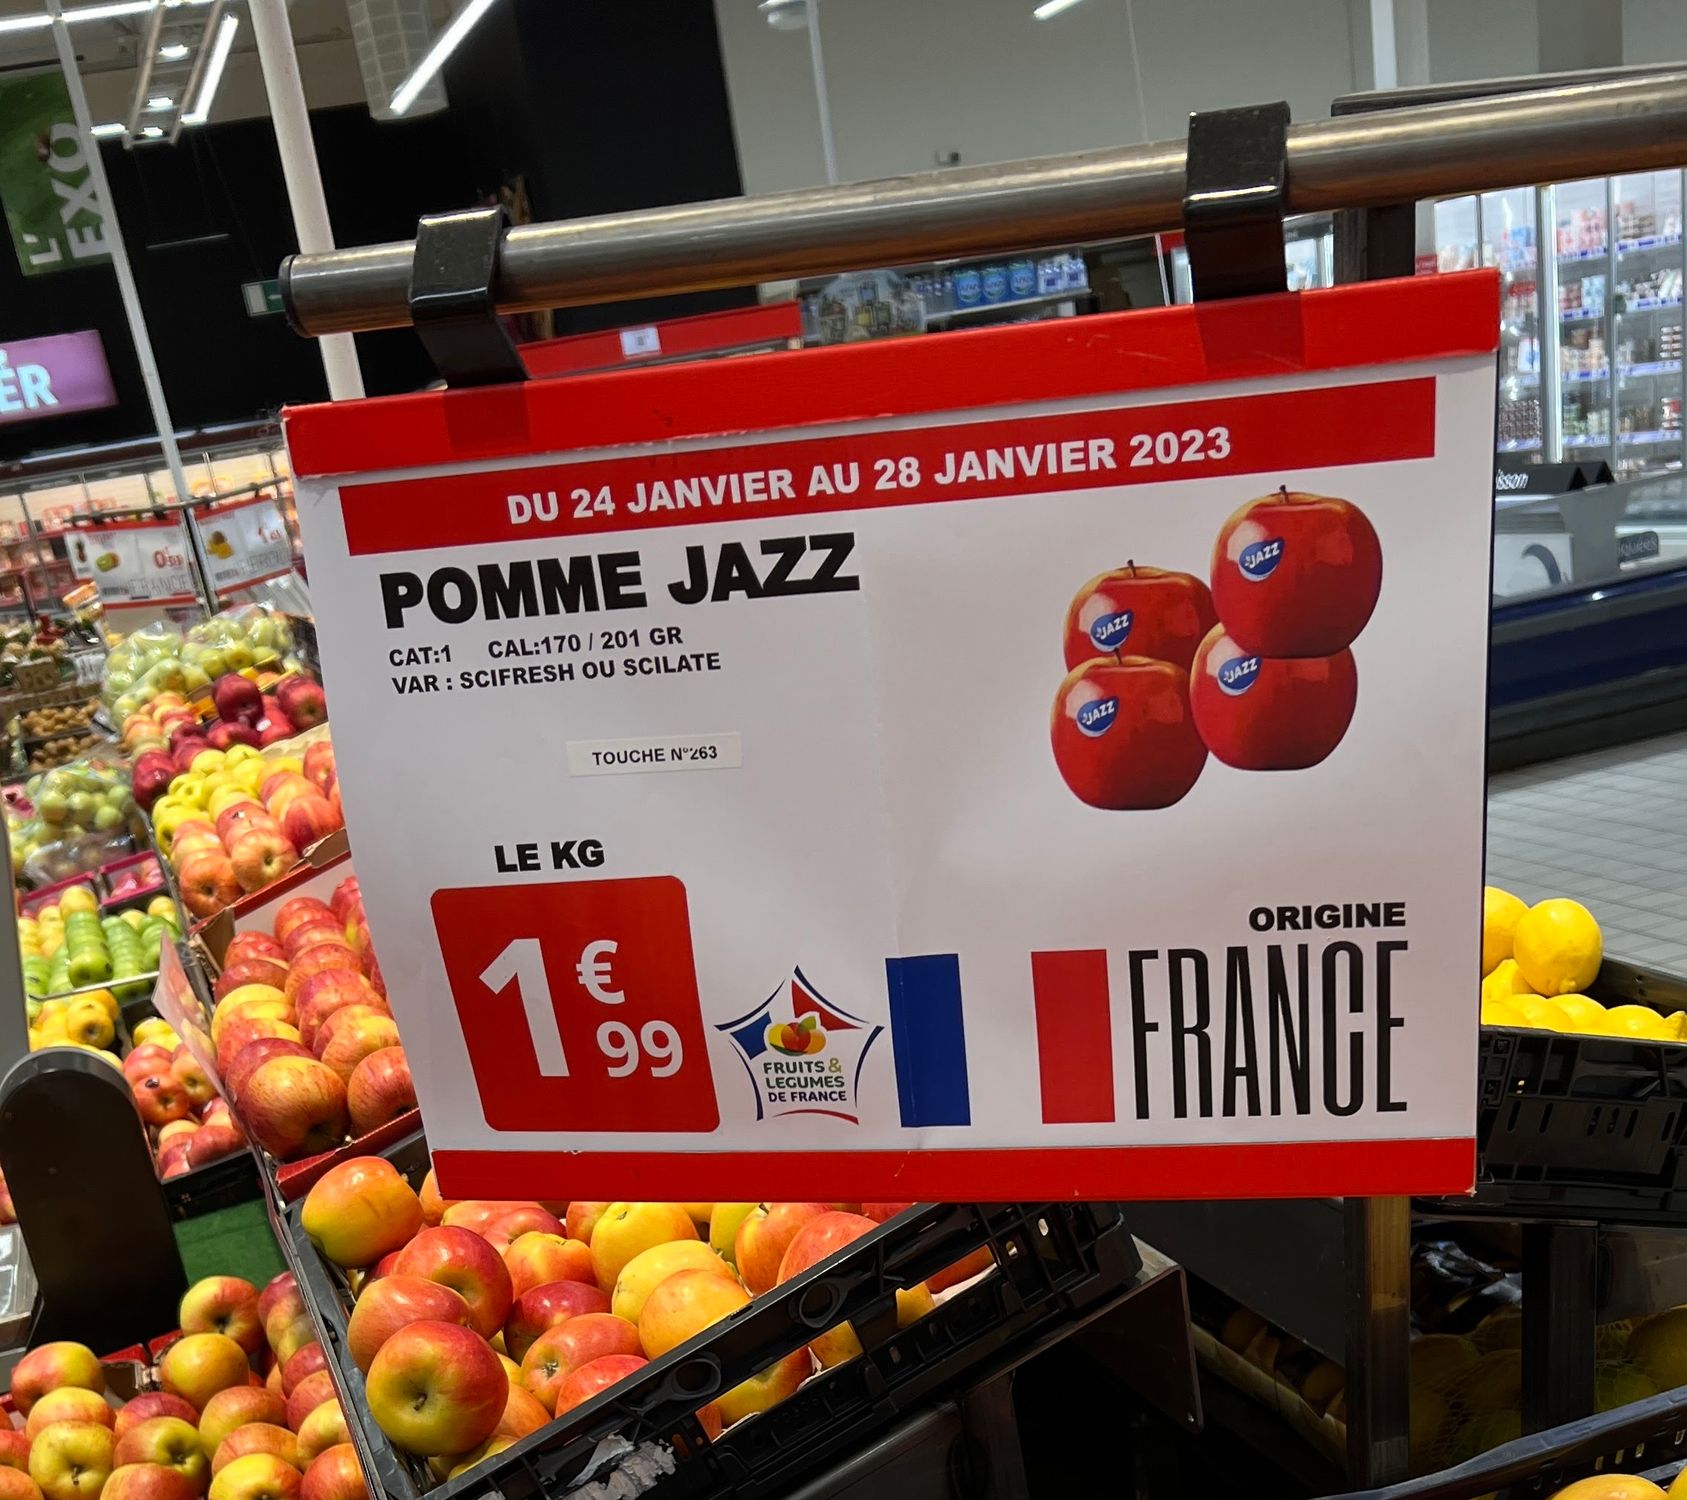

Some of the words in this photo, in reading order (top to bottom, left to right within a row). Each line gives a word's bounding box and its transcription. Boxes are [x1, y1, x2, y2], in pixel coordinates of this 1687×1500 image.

[507, 491, 559, 525] DU
[572, 487, 616, 520] 24
[627, 467, 796, 515] JANVIER
[807, 461, 861, 497] AU
[874, 456, 921, 491] 28
[935, 438, 1117, 486] JANVIER
[1130, 426, 1231, 468] 2023
[1249, 541, 1280, 569] JAZZ
[379, 550, 648, 630] POMME
[667, 531, 860, 605] JAZZ
[1101, 614, 1130, 640] JAZZ
[388, 643, 453, 668] CAT:1
[487, 632, 582, 659] CAL:170
[600, 627, 641, 651] 201
[649, 625, 684, 647] GR
[391, 674, 441, 696] VAR
[460, 663, 575, 690] SCIFRESH
[582, 659, 616, 680] OU
[623, 651, 721, 676] SCILATE
[1228, 657, 1258, 683] JAZZ
[1086, 700, 1116, 726] JAZZ
[592, 748, 666, 766] TOUCHE
[494, 843, 541, 873] LE
[551, 839, 606, 869] KG
[1249, 902, 1406, 931] ORIGINE
[575, 939, 625, 1005] €
[478, 938, 570, 1077] 1
[1128, 940, 1409, 1120] FRANCE
[596, 1020, 684, 1078] 99
[763, 1061, 825, 1074] FRUITS
[828, 1057, 842, 1073] &
[768, 1092, 786, 1102] DE
[790, 1090, 847, 1102] FRANCE
